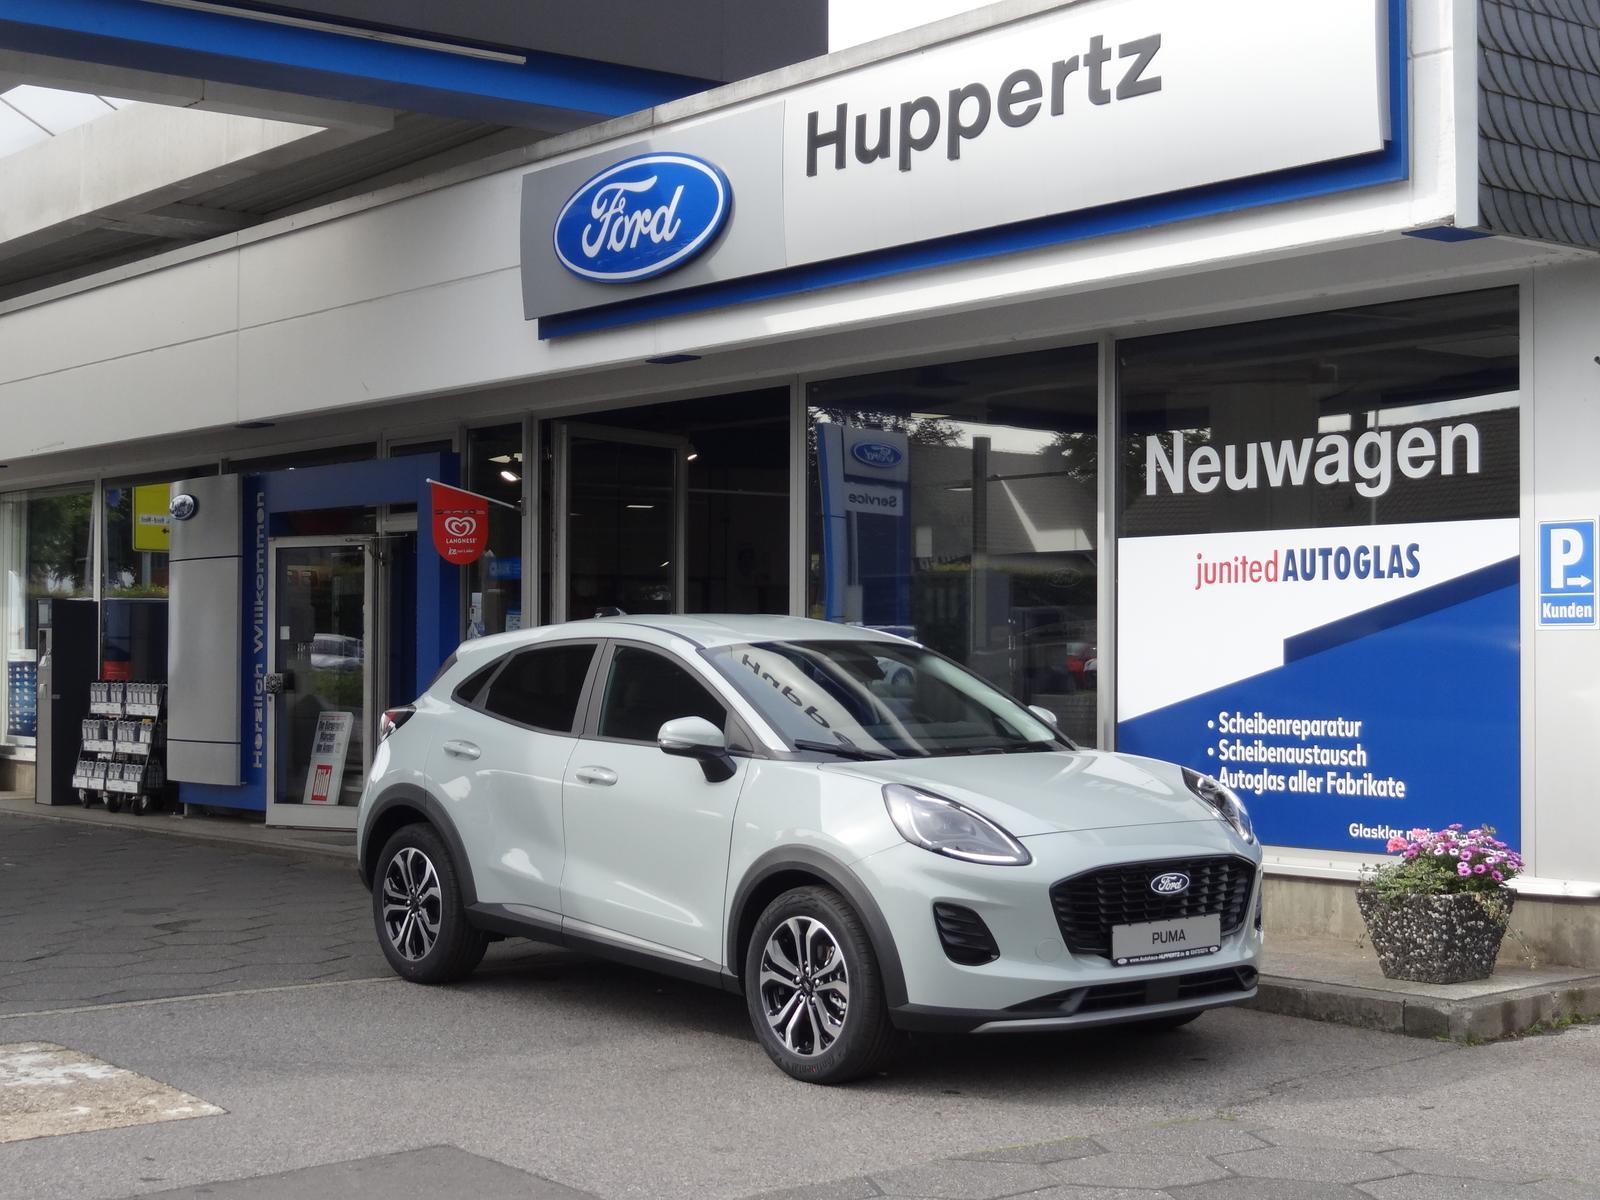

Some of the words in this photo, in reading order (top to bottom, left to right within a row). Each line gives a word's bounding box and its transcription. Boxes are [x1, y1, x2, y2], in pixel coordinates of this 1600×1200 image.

[806, 33, 1162, 177] Huppertz
[581, 175, 684, 258] Ford
[1146, 423, 1479, 498] Neuwagen
[253, 492, 264, 654] Willkommen
[1550, 528, 1583, 589] P
[1542, 602, 1592, 618] Kunden
[253, 663, 263, 768] Herzlich
[1218, 711, 1362, 741] Scheibenreparatur
[1218, 739, 1367, 767] Scheibenaustausch
[1219, 766, 1285, 795] Autoglas
[1288, 770, 1323, 793] aller
[1327, 772, 1405, 798] Fabrikate
[1349, 823, 1403, 840] Glasklar
[1158, 876, 1183, 891] Ford
[1152, 929, 1186, 944] PUMA
